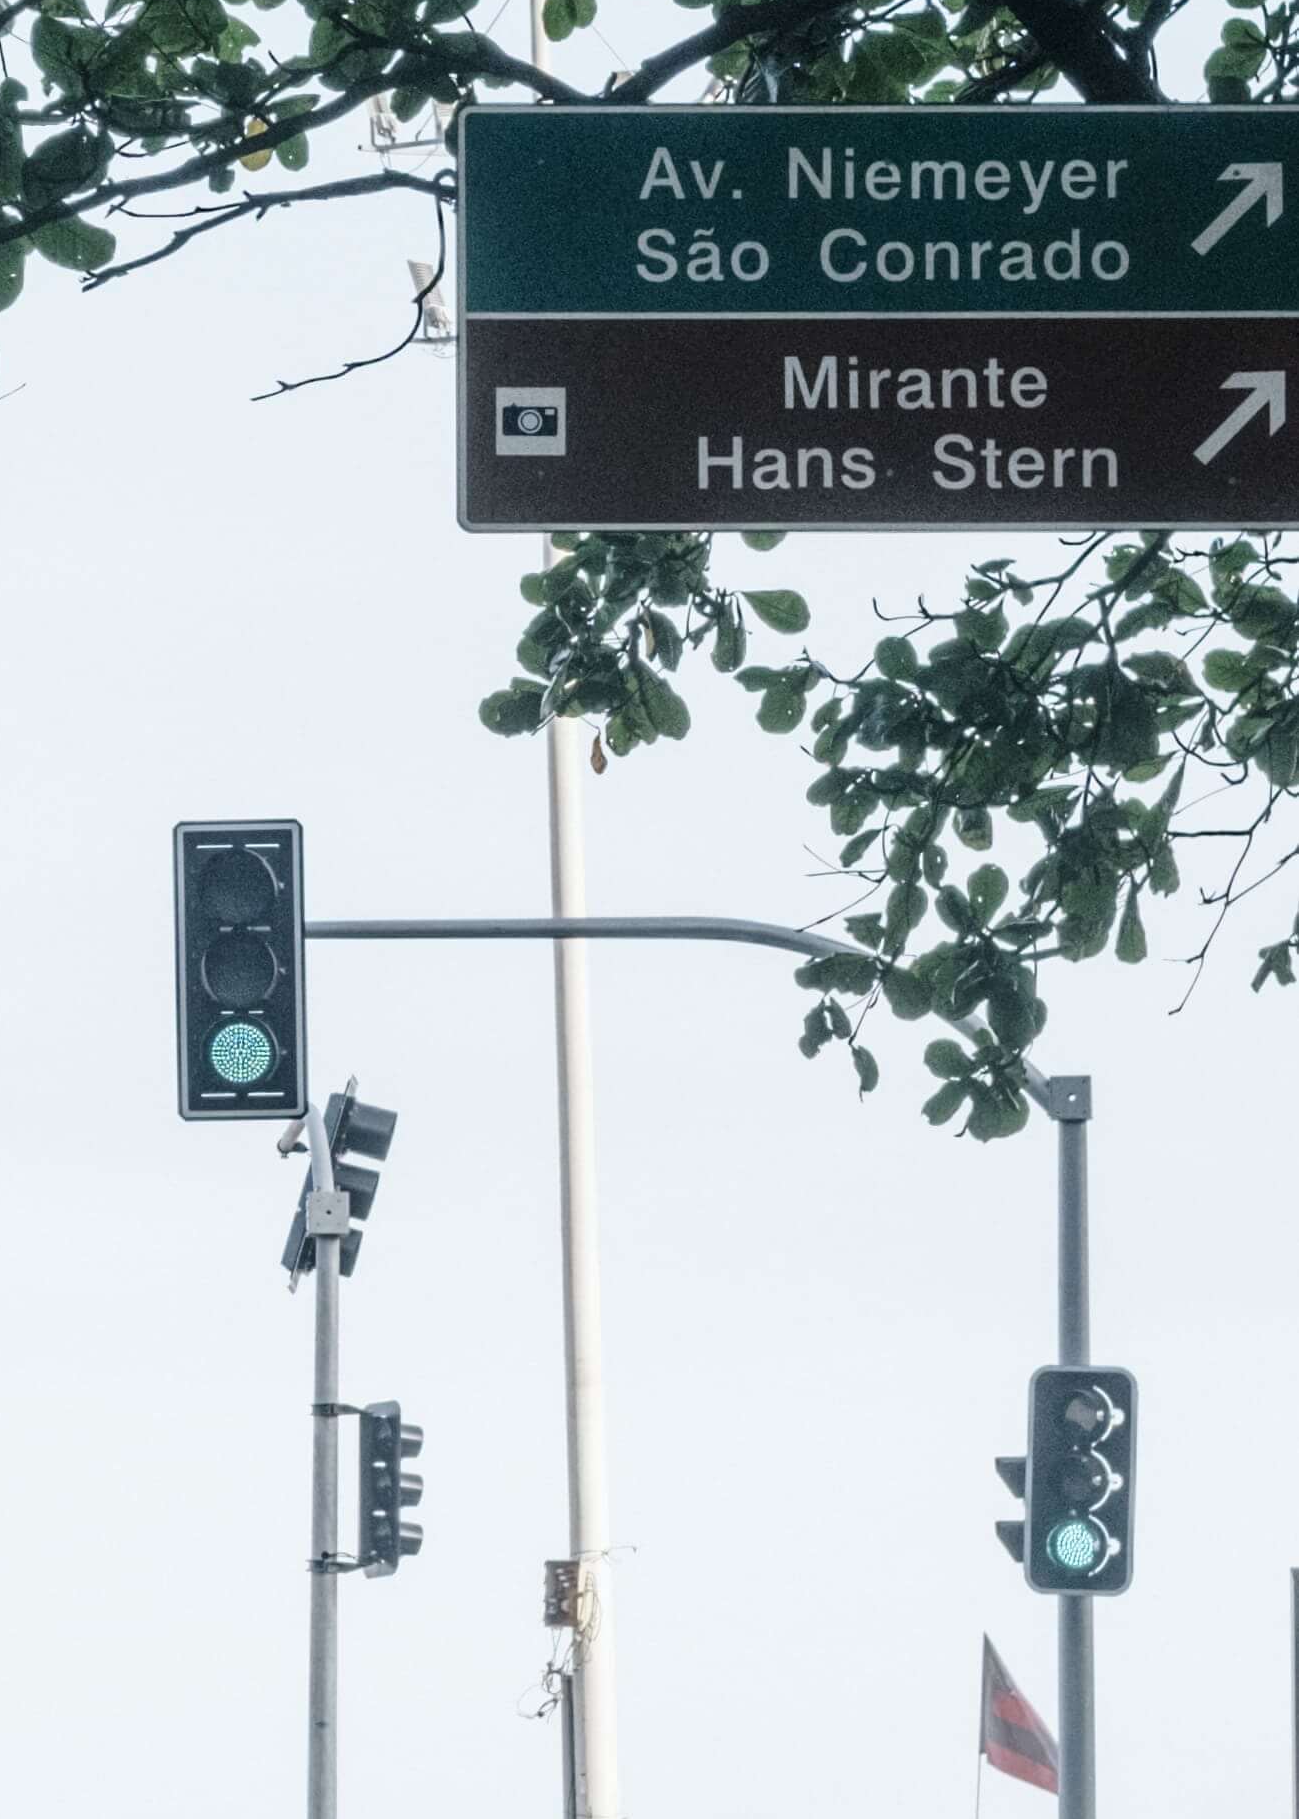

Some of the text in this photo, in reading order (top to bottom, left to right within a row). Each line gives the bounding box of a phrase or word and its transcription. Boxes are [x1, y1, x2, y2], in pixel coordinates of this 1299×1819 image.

[640, 147, 1128, 214] Av. Niemeyer
[637, 228, 1130, 283] São Conrado
[784, 356, 1048, 410] Mirante
[699, 434, 1118, 490] Hans Stern
